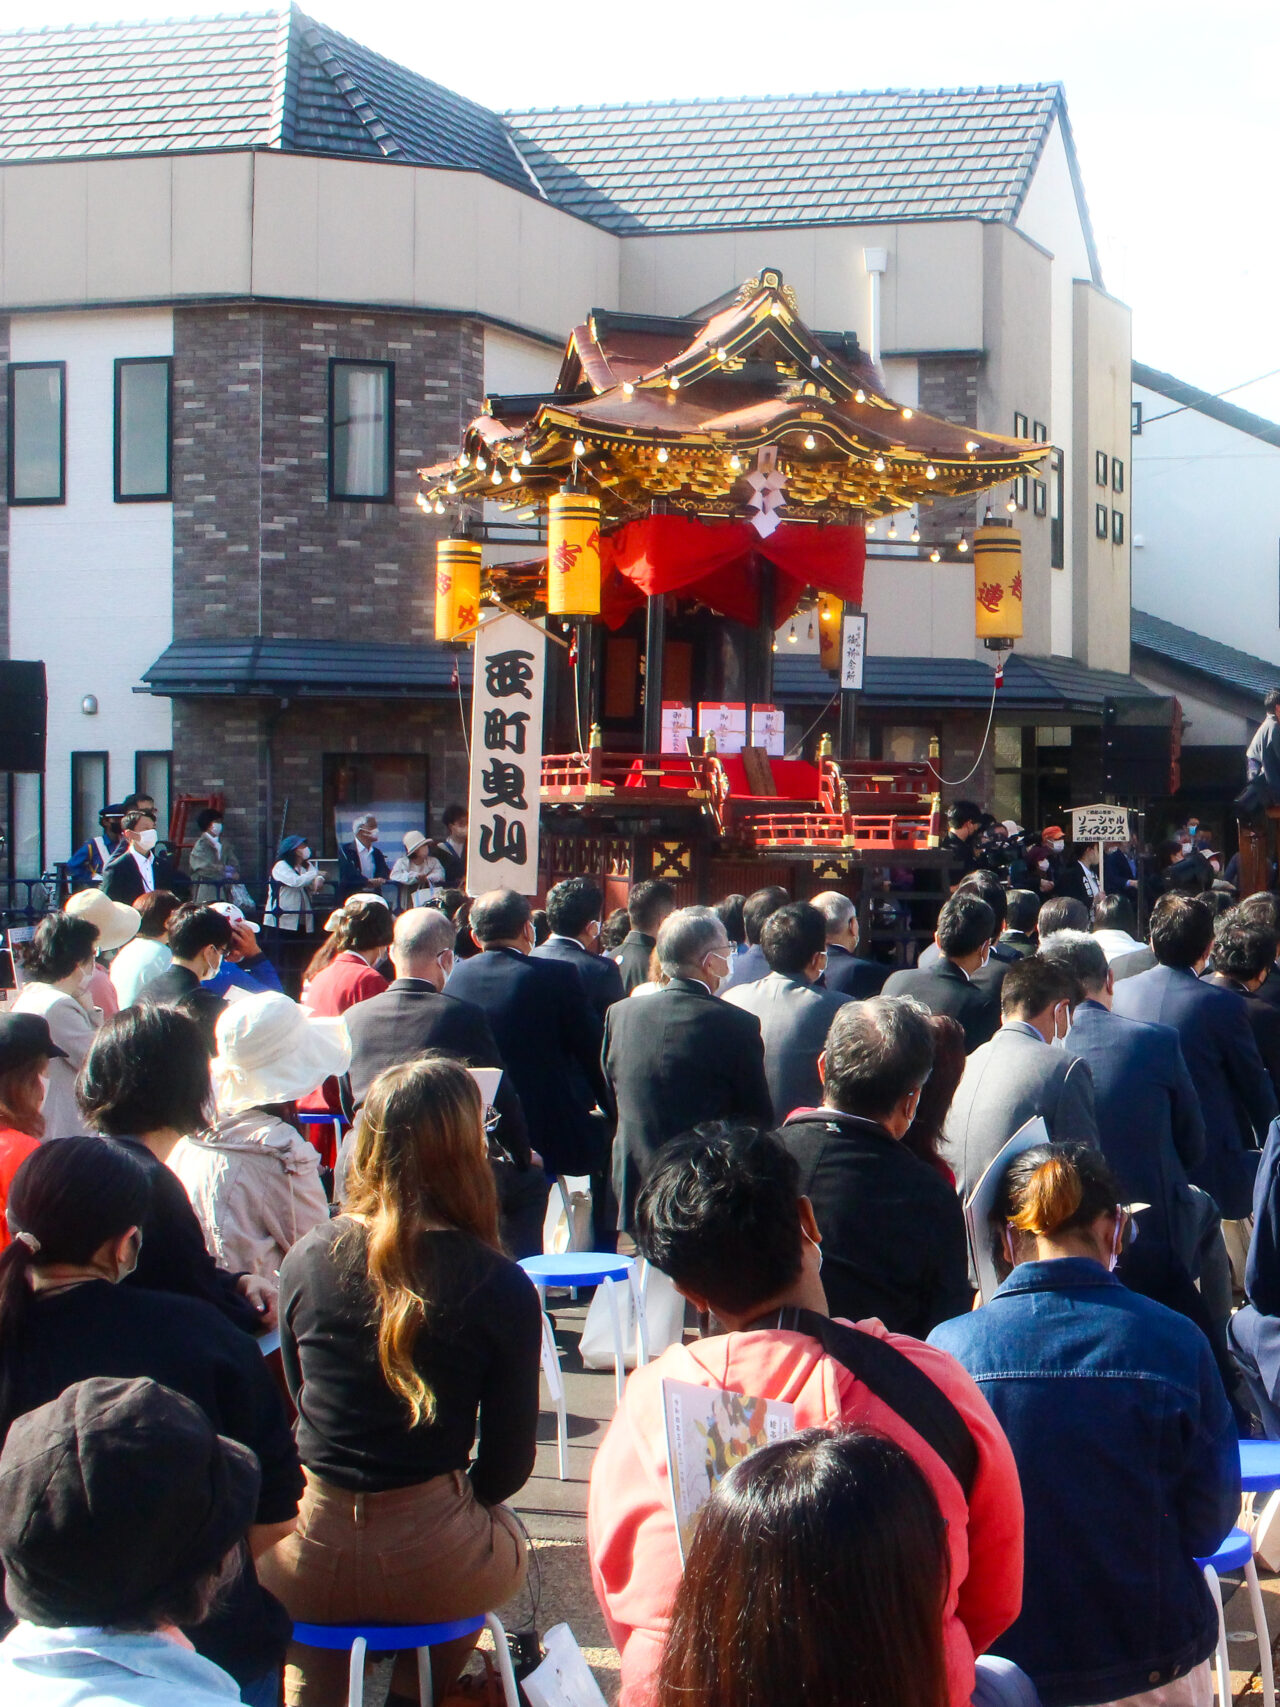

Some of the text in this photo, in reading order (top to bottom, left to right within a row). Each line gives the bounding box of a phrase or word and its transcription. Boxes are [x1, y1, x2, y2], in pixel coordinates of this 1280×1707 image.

[479, 649, 535, 866] 西町曳山
[1078, 815, 1125, 825] ソーシャル
[1078, 825, 1125, 836] ディスタンス
